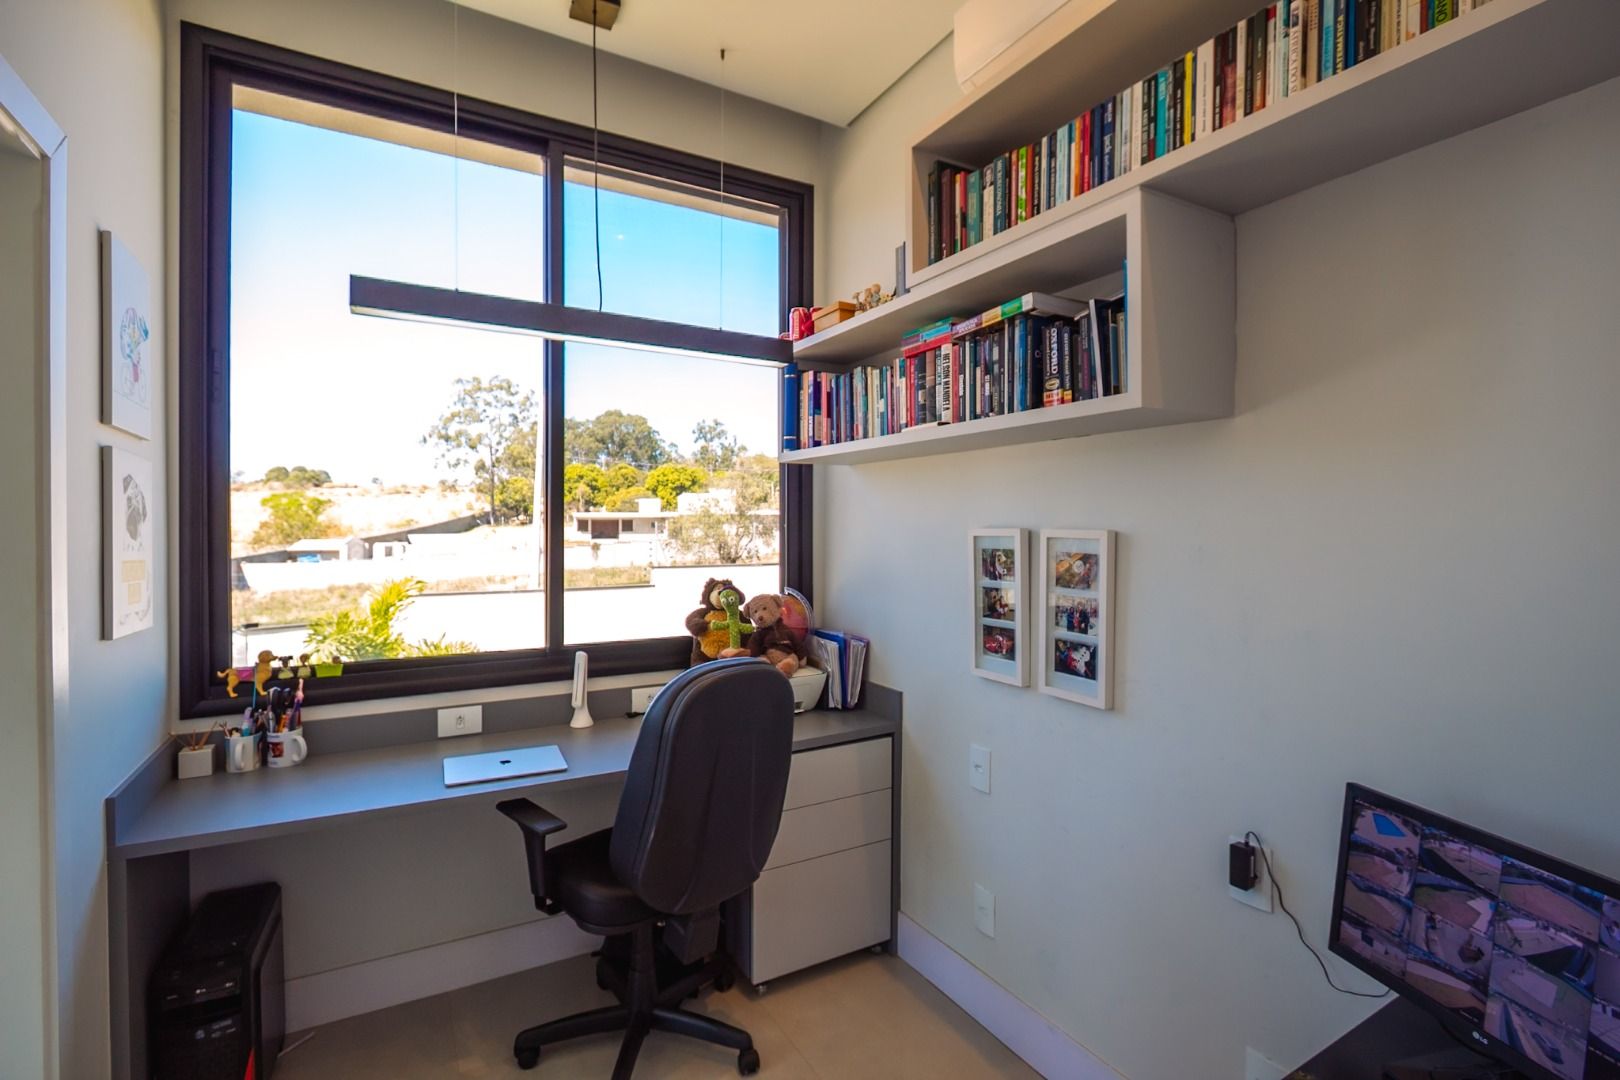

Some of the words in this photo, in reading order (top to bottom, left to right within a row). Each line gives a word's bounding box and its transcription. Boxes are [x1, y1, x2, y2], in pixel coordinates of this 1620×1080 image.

[1051, 327, 1059, 374] OXFORD
[942, 353, 950, 380] NELSON
[942, 380, 950, 411] MANDELA
